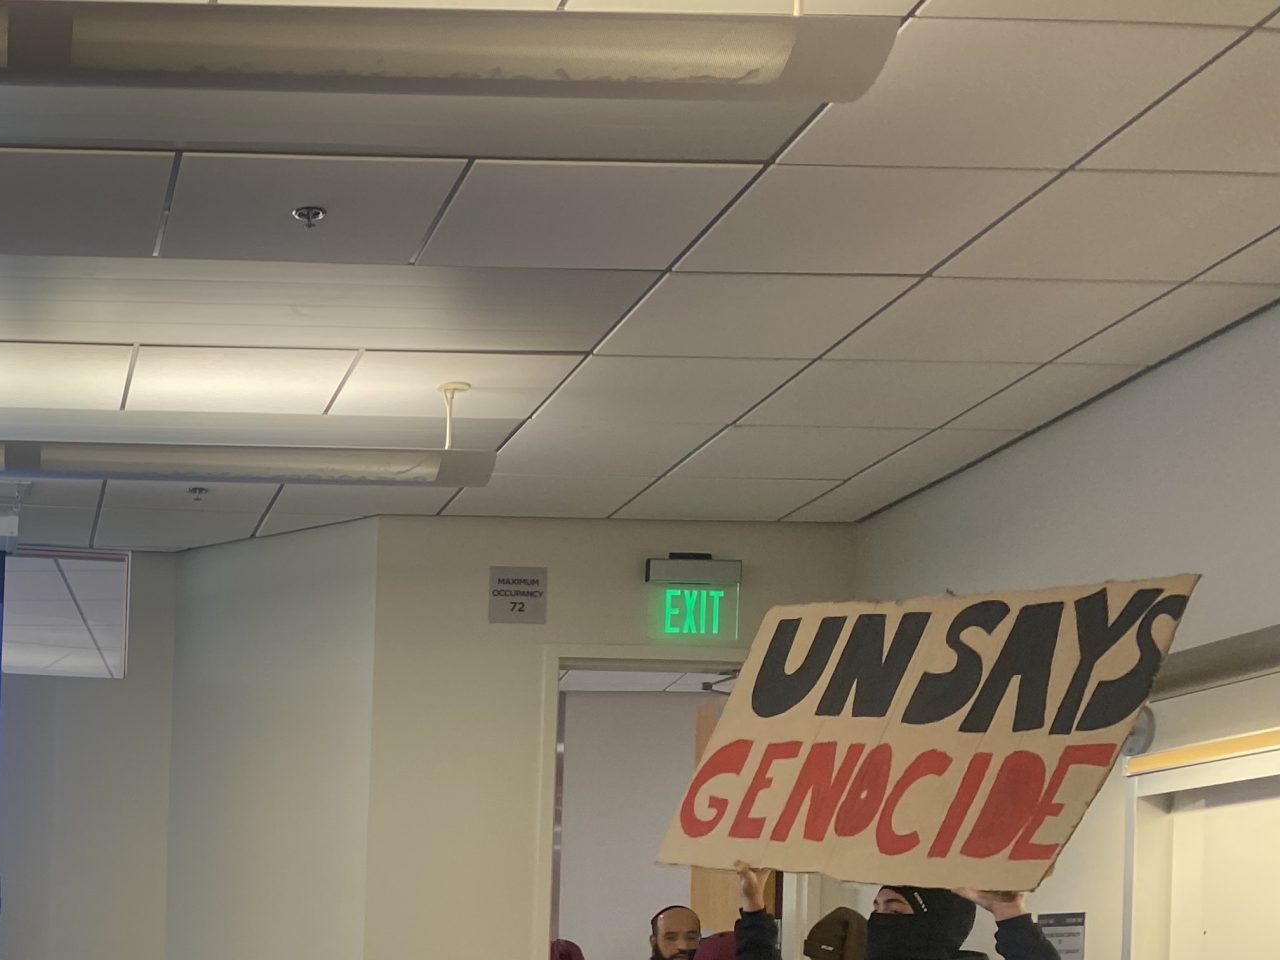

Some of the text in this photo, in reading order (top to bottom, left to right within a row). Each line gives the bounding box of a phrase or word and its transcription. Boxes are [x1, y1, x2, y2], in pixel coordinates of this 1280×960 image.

[492, 589, 544, 598] OCCUPANCY
[497, 578, 540, 586] MAXIMUM
[510, 601, 526, 612] 72
[665, 589, 725, 635] EXIT
[750, 587, 1191, 736] UN SAYS
[679, 739, 1118, 861] GENOCIDE
